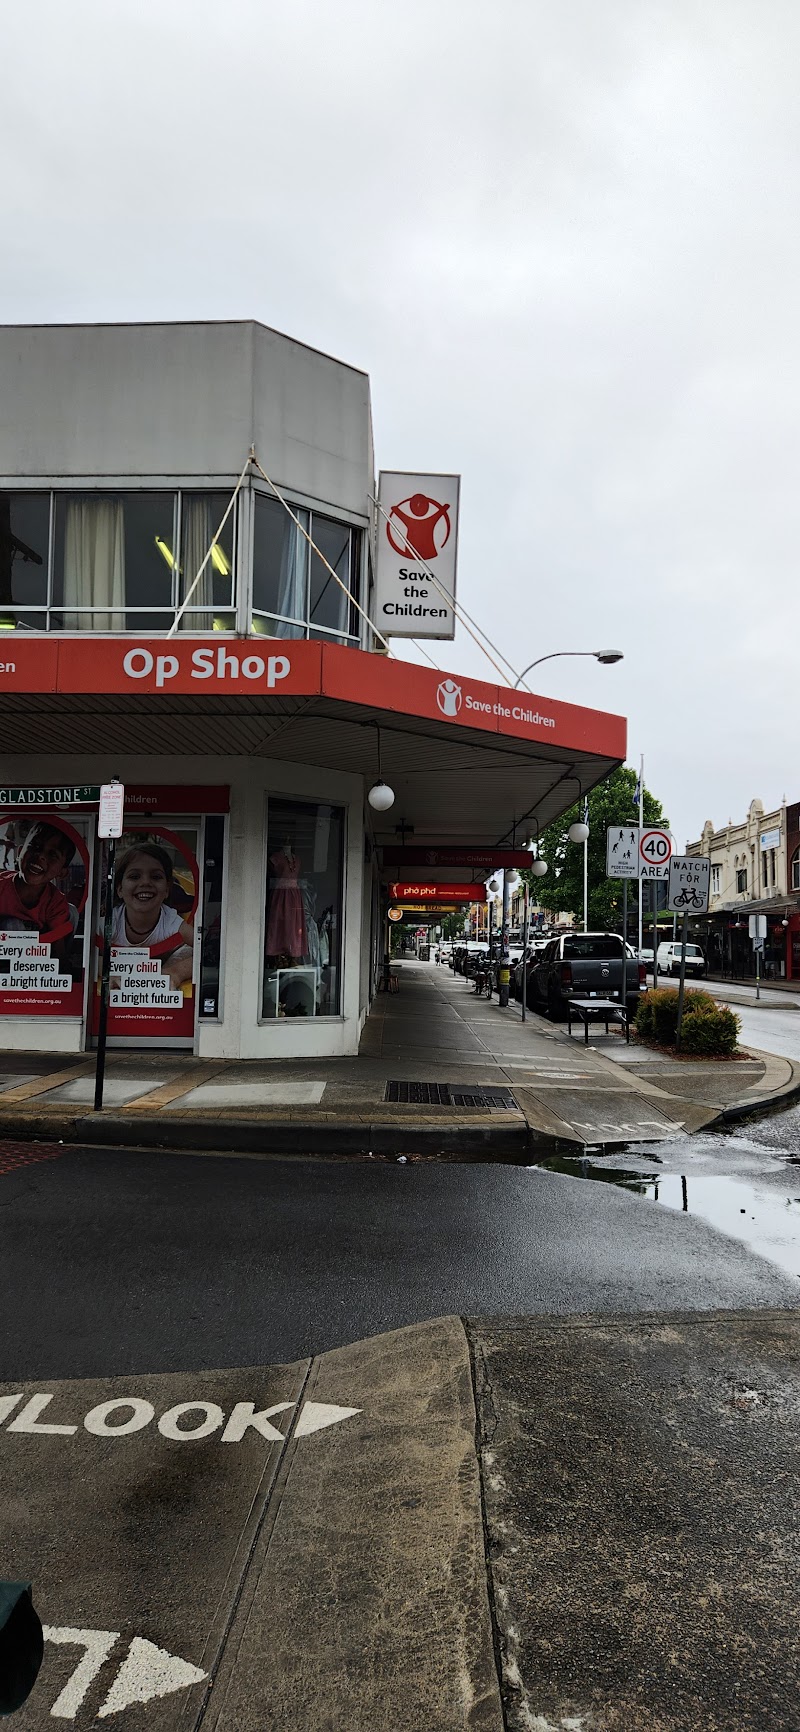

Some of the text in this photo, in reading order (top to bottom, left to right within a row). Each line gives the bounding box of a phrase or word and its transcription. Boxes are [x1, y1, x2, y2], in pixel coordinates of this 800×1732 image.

[398, 568, 435, 582] Save
[403, 586, 429, 599] the
[383, 603, 448, 618] Children
[122, 646, 292, 688] Op Shop
[465, 696, 555, 728] Save the Children
[0, 787, 92, 803] GLADSTONE ST
[124, 794, 158, 804] hildren
[644, 839, 668, 857] 40
[640, 866, 669, 877] AREA
[673, 861, 708, 872] WATCH
[679, 874, 700, 884] FOR
[0, 945, 48, 958] Every child
[13, 960, 55, 972] deserves
[110, 961, 158, 974] Every child
[1, 975, 69, 989] a bright future
[124, 976, 166, 988] deserves
[112, 991, 180, 1005] a bright future
[6, 1392, 297, 1443] LOOK
